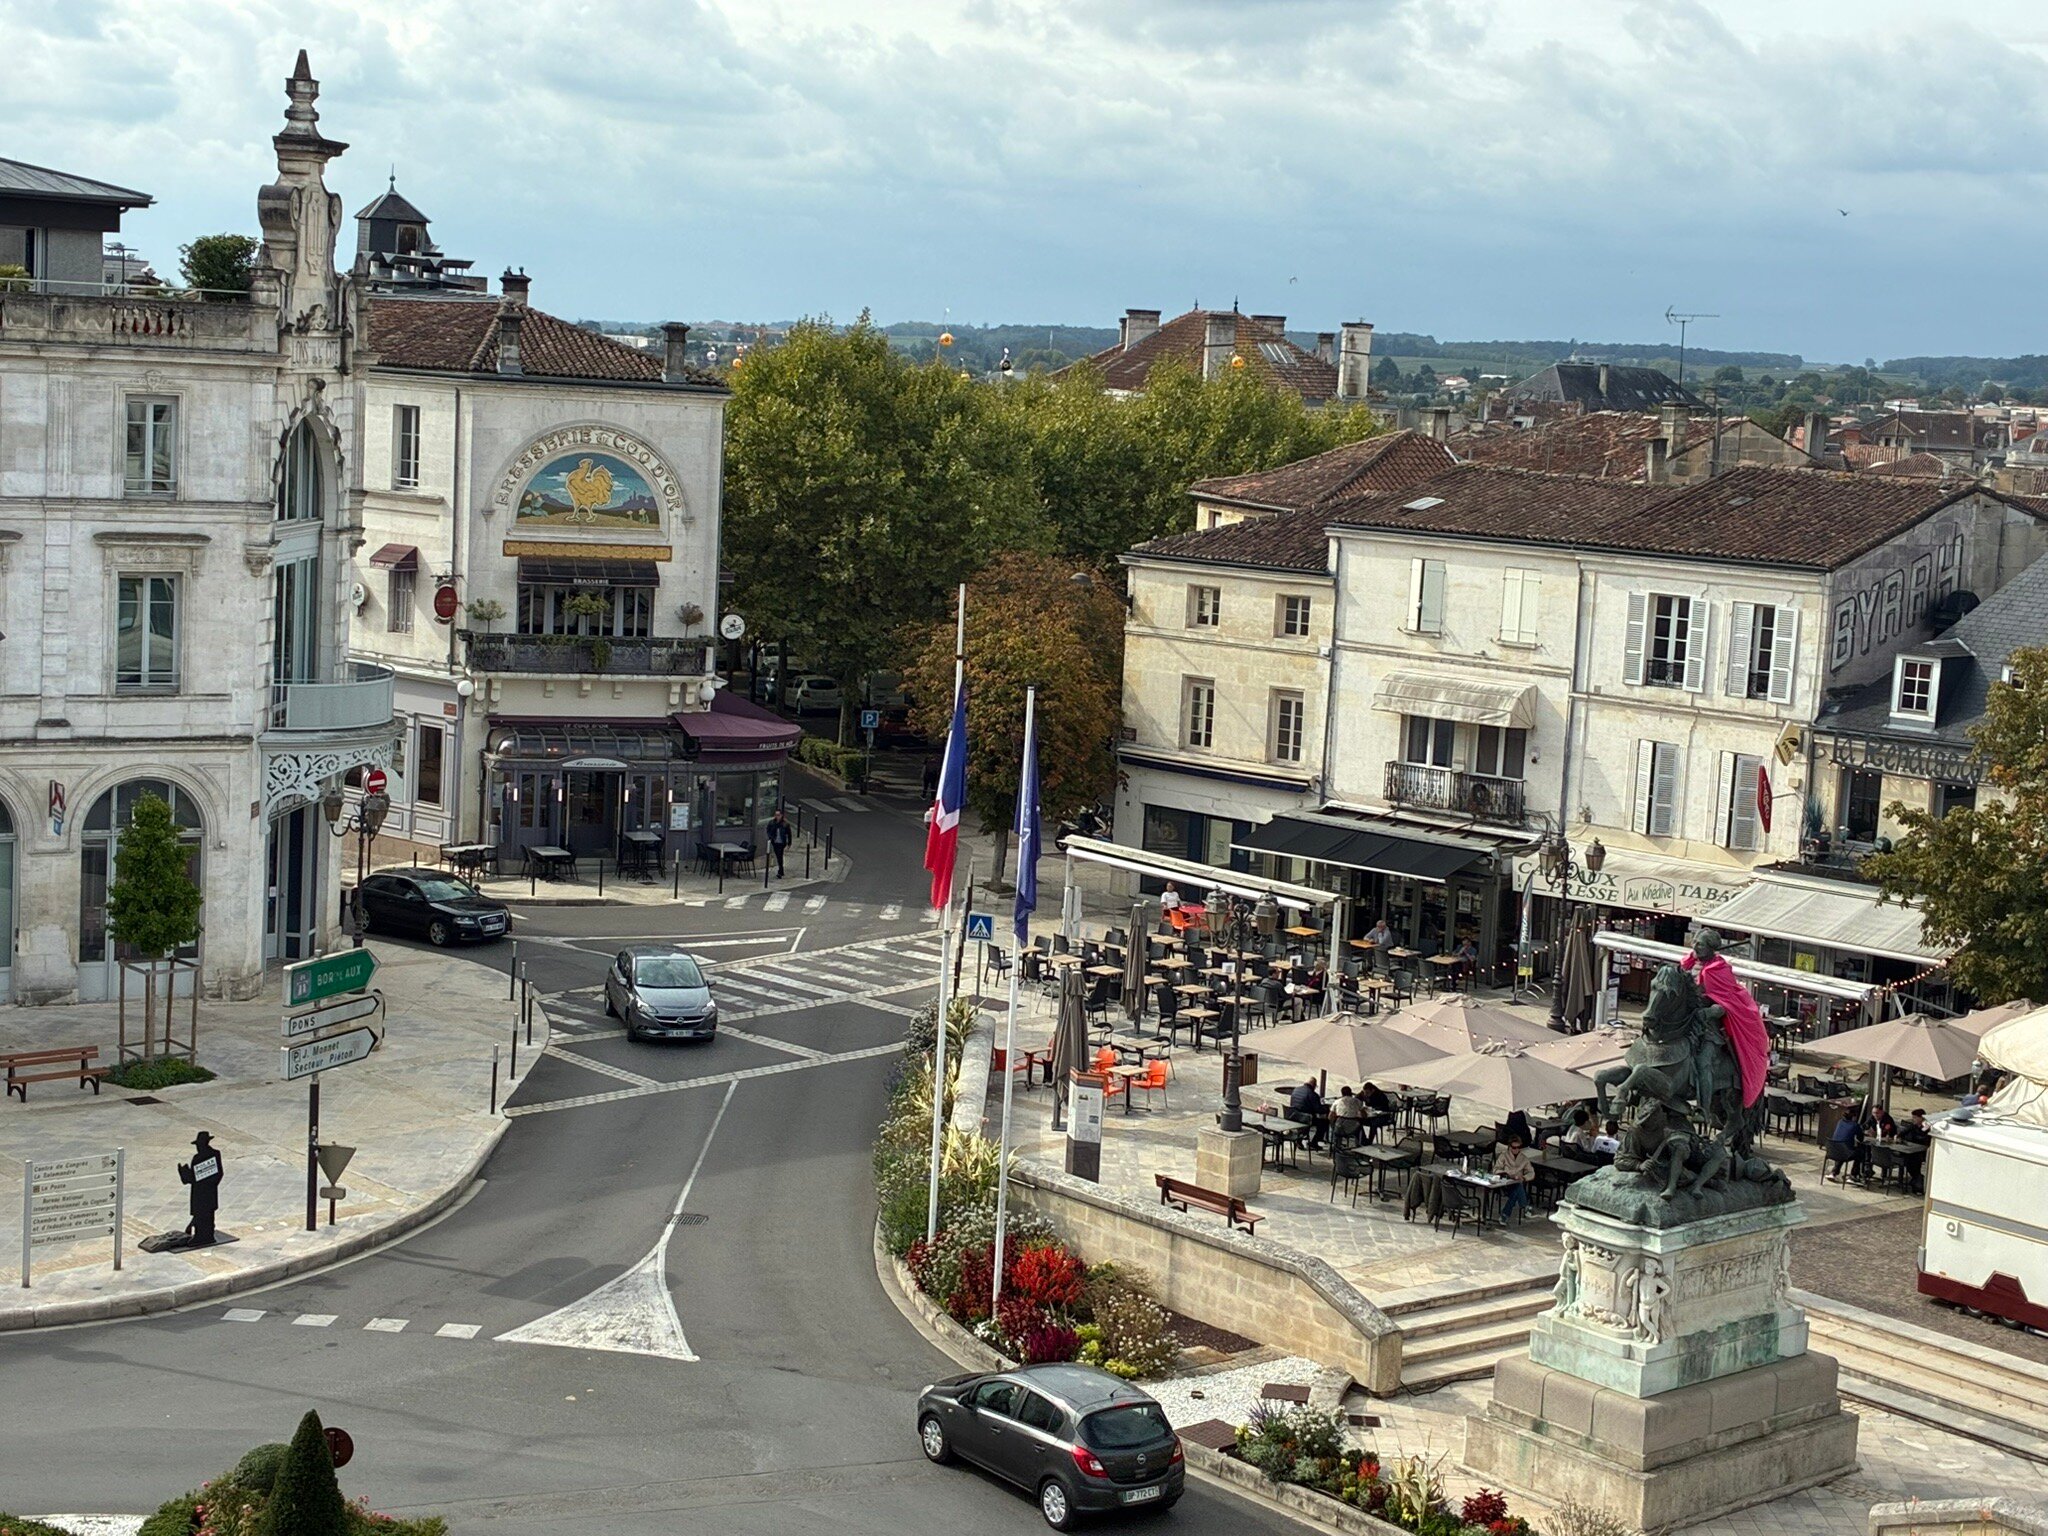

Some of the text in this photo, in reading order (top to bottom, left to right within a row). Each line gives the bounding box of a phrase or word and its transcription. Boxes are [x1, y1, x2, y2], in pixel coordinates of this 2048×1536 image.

[573, 577, 610, 585] BRASSERIE
[1830, 531, 1964, 673] BYRRH
[1627, 887, 1639, 902] Au
[292, 1016, 315, 1032] PONS
[302, 1050, 309, 1059] J.
[313, 1041, 340, 1056] Monnet
[33, 1217, 57, 1225] Chambre
